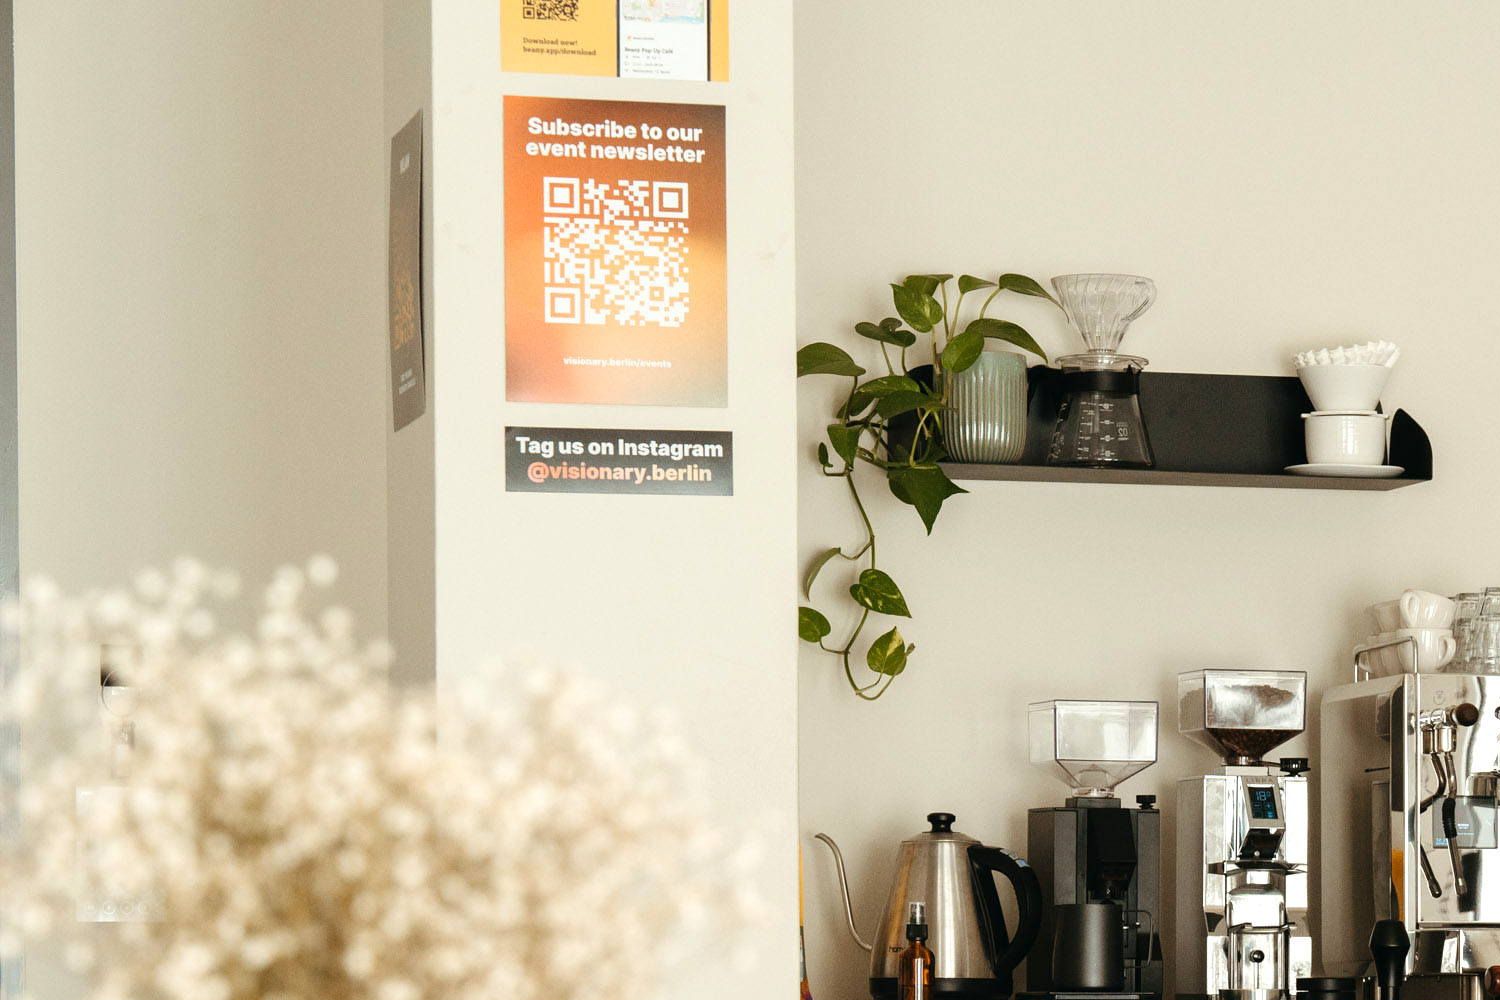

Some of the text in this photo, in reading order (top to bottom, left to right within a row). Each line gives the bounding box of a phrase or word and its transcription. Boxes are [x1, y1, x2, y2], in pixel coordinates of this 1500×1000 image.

[523, 37, 559, 45] Download
[528, 117, 703, 142] Subscribe to our
[525, 141, 706, 163] event newsletter
[562, 357, 672, 369] visionary.berlin/events
[515, 436, 724, 460] Tag us on Instagram
[527, 461, 713, 484] @visionary.berlin
